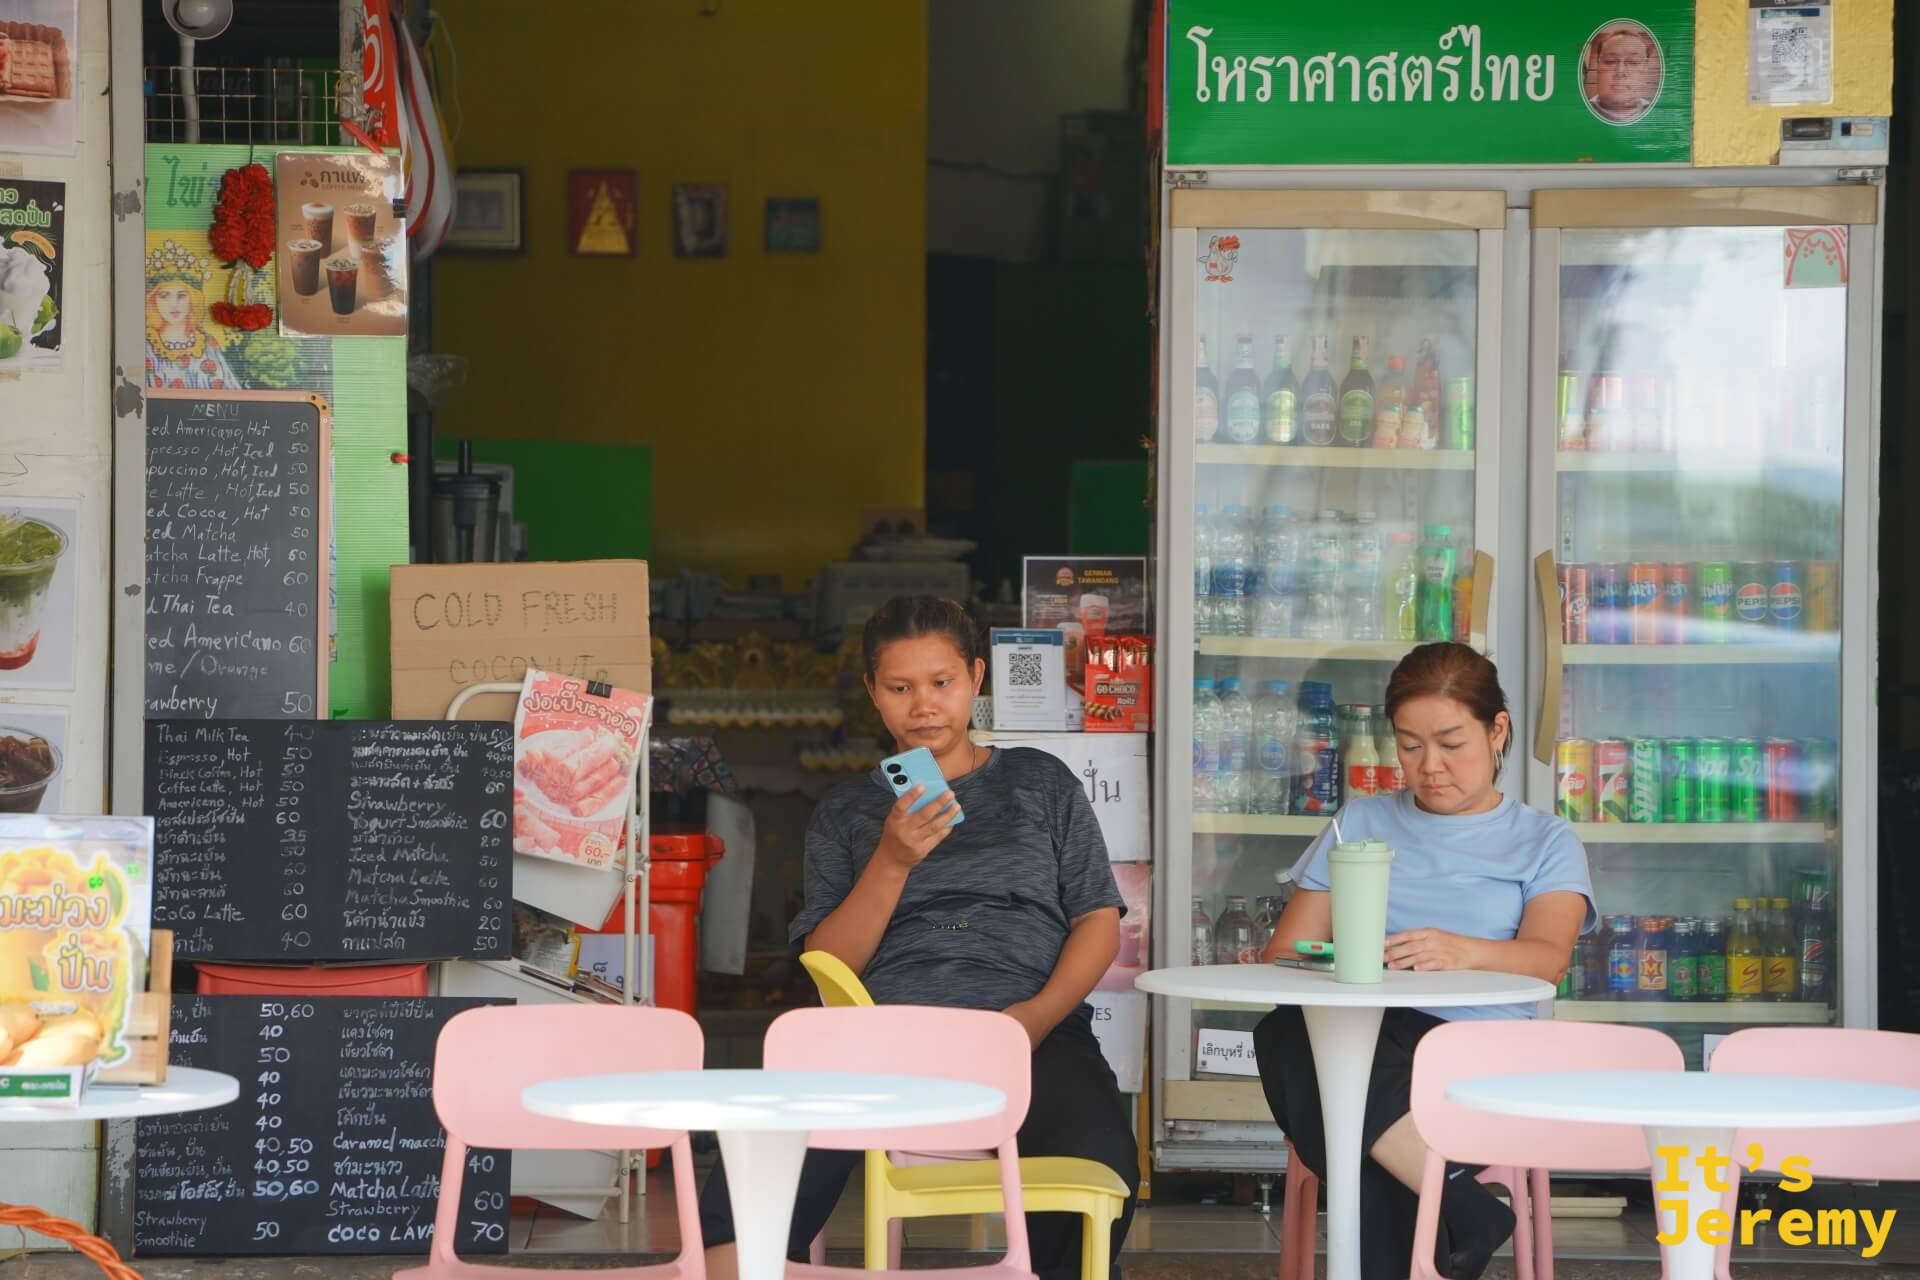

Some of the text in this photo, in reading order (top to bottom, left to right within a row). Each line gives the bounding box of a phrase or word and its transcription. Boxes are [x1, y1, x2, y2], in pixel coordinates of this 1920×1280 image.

[1187, 24, 1555, 102] โหราศาสตร์ไทย
[192, 404, 239, 417] MENU
[147, 416, 170, 435] ed
[247, 420, 270, 437] Hot
[288, 422, 309, 434] 50
[288, 443, 309, 454] 50
[252, 464, 278, 477] Iced
[288, 463, 308, 475] 50
[255, 483, 281, 497] Iced
[289, 483, 309, 495] 50
[244, 504, 270, 520] Hot
[289, 507, 310, 518] 50
[146, 522, 309, 542] ed Matcha 50
[288, 544, 307, 560] 60
[197, 564, 243, 594] Frappe
[283, 572, 308, 586] 60
[163, 595, 195, 614] Thai
[205, 595, 235, 616] Tea
[285, 602, 308, 616] 40
[414, 591, 617, 632] COLD FRESH
[184, 623, 282, 650] Americano
[289, 636, 311, 654] 60
[281, 691, 312, 713] 50
[157, 724, 314, 743] Thai Milk Tea 40
[227, 748, 251, 761] Hot
[282, 747, 312, 760] 50
[240, 760, 263, 778] Hot
[281, 764, 304, 776] 50
[158, 783, 196, 794] Coffee
[240, 780, 263, 792] Hot
[280, 781, 304, 792] 50
[242, 796, 264, 808] Hot
[276, 796, 299, 806] 50
[348, 790, 446, 816] Strawberry
[276, 812, 300, 824] 60
[480, 809, 507, 829] 60
[280, 829, 306, 842] 35
[480, 836, 499, 847] 20
[280, 847, 305, 856] 50
[348, 848, 386, 862] Iced
[480, 856, 498, 867] 50
[284, 862, 306, 875] 60
[284, 883, 304, 895] 60
[410, 889, 470, 908] Smoothie
[483, 898, 502, 910] 60
[204, 904, 245, 922] Latte
[282, 904, 307, 920] 60
[478, 916, 500, 930] 20
[281, 931, 311, 950] 40
[473, 936, 497, 951] 50
[58, 934, 110, 990] ปั่น
[260, 1003, 314, 1020] 50,60
[259, 1025, 282, 1040] 40
[258, 1047, 290, 1063] 50
[1202, 1040, 1243, 1061] เลิกบุหรี่
[258, 1071, 280, 1087] 40
[256, 1092, 281, 1110] 40
[256, 1115, 282, 1132] 40
[255, 1137, 313, 1156] 40,50
[333, 1127, 397, 1152] Caramel
[254, 1159, 309, 1177] 40,50
[469, 1155, 494, 1174] 40
[253, 1180, 319, 1201] 50,60
[330, 1174, 503, 1211] Matcha Latte 60
[136, 1209, 208, 1235] Strawberry
[326, 1201, 420, 1226] Strawberry
[136, 1230, 197, 1248] Smoothie
[253, 1222, 279, 1240] 50
[471, 1222, 503, 1242] 70
